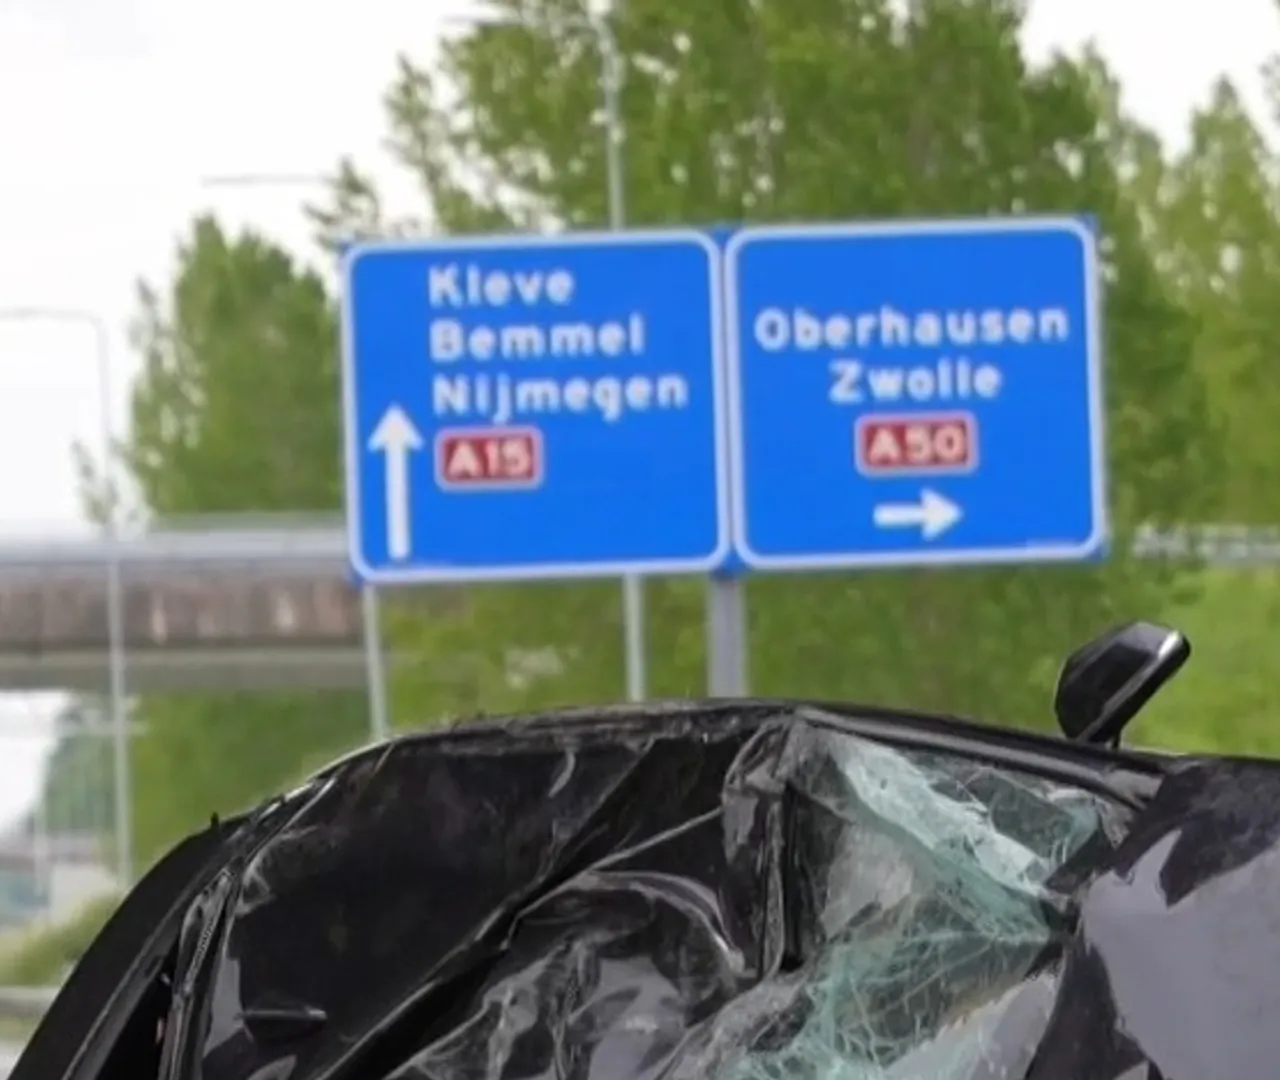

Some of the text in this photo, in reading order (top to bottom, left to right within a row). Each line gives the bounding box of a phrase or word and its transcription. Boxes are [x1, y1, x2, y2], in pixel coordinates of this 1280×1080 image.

[429, 262, 574, 309] Kleve
[430, 312, 645, 362] Bemmel
[754, 304, 1069, 351] Oberhausen
[433, 372, 688, 425] Nijmegen
[828, 355, 1002, 403] Zwolle
[447, 440, 532, 477] A15
[868, 422, 967, 463] A50
